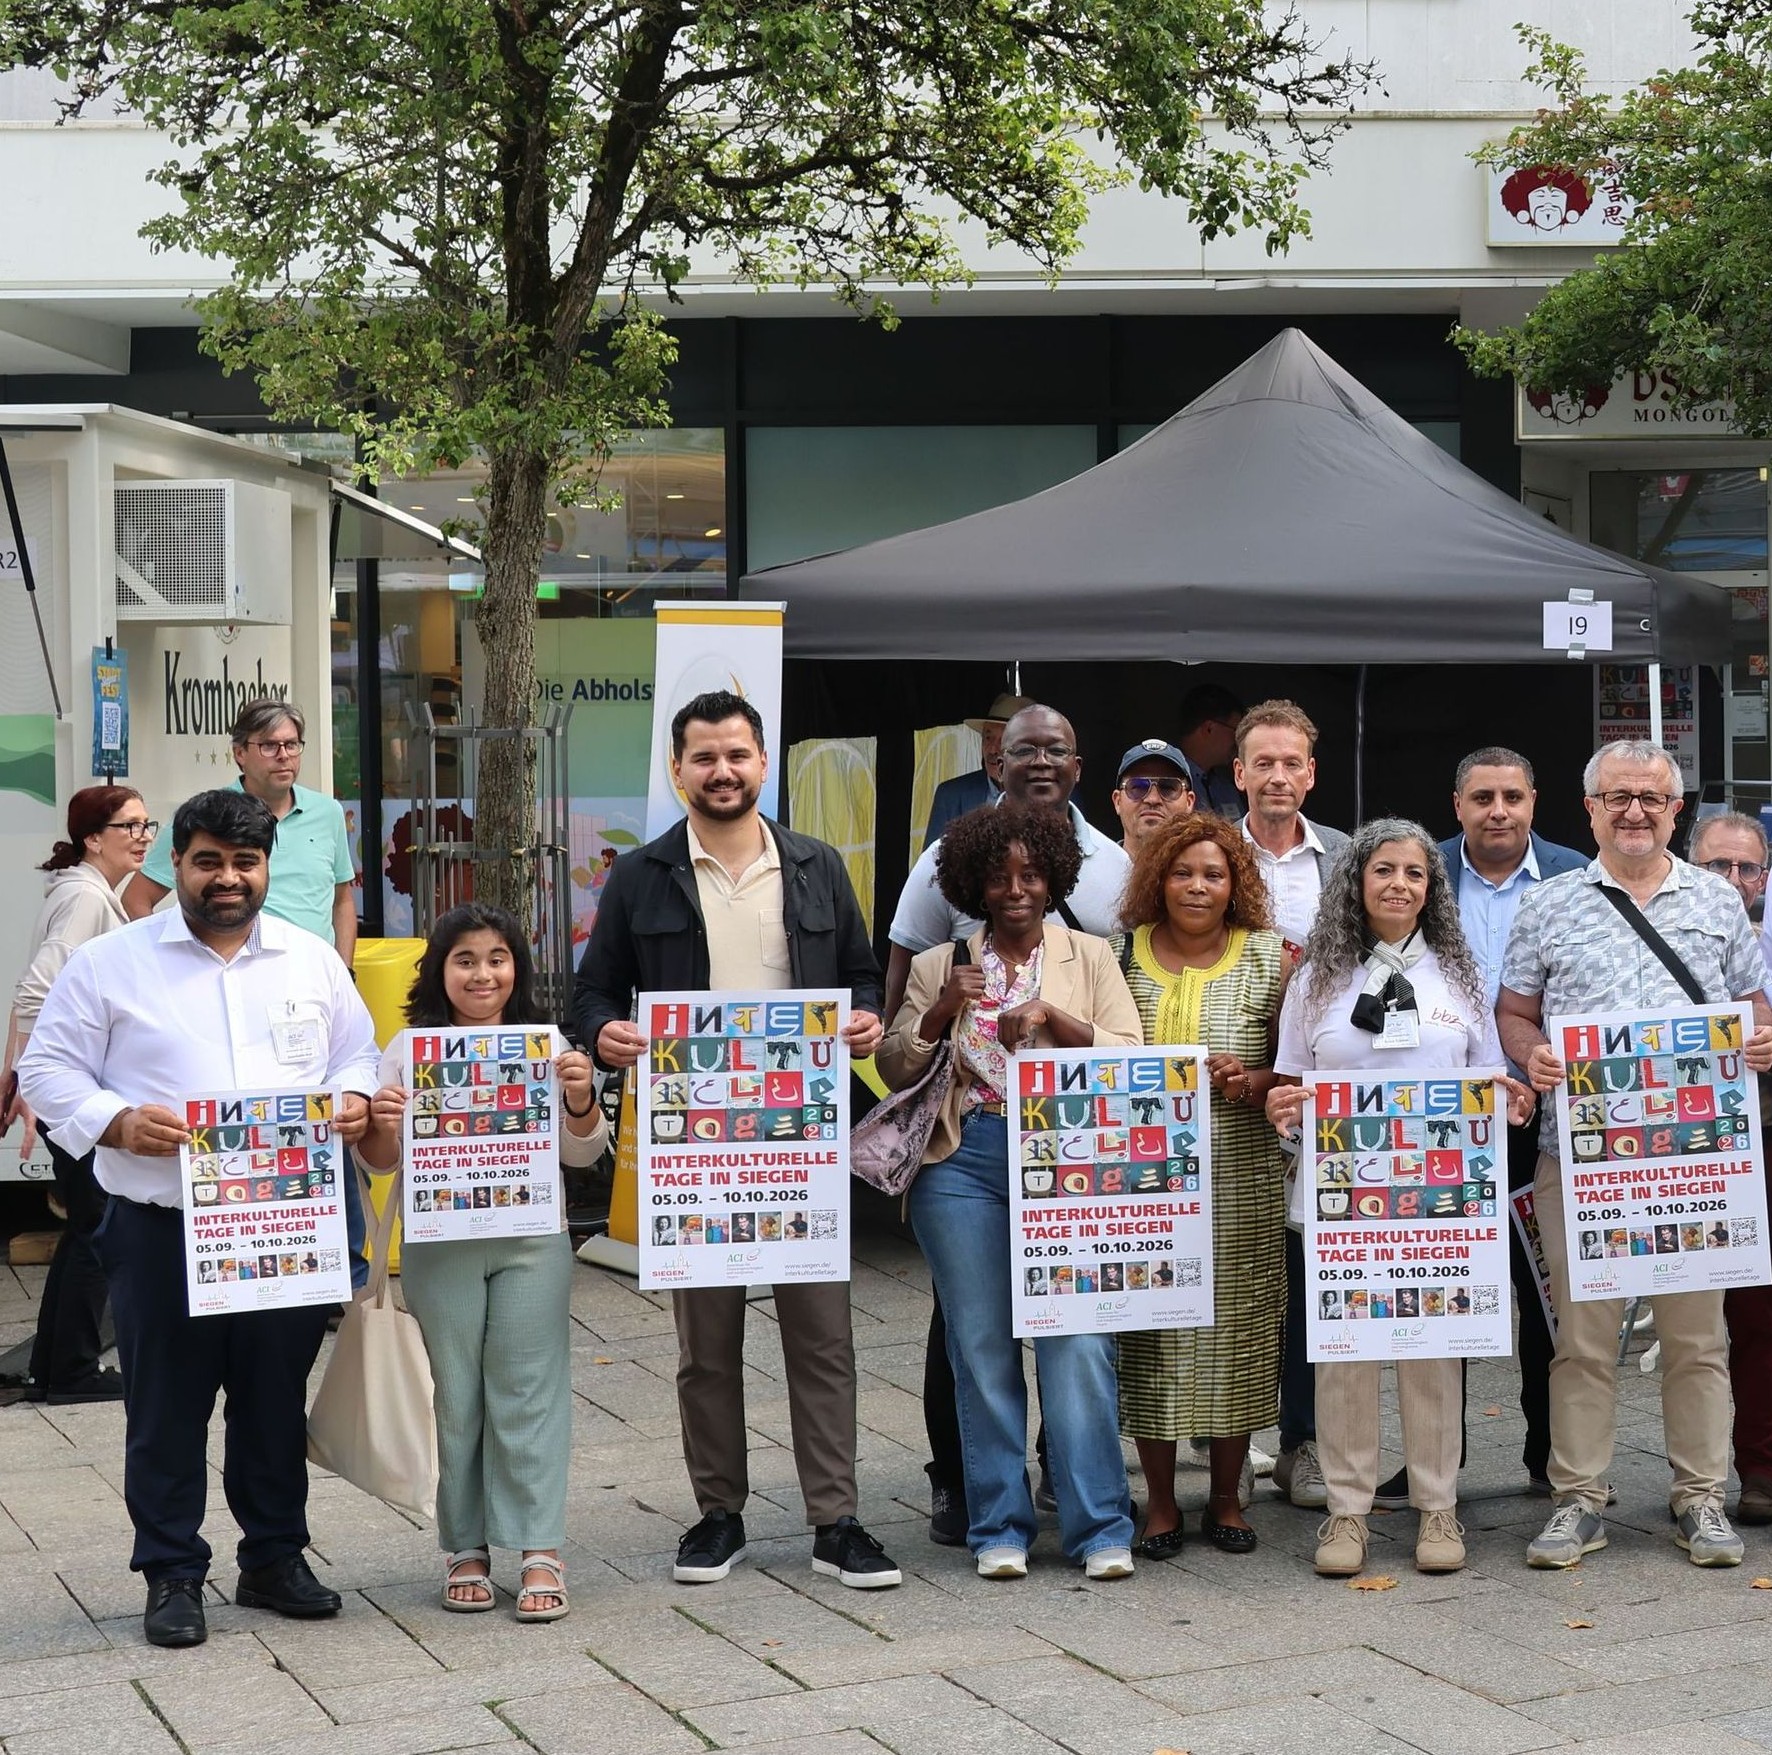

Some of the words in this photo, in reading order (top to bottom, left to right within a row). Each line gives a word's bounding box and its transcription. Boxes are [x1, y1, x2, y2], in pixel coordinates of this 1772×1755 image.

[1633, 408, 1730, 423] MONGOL
[572, 678, 656, 701] Abhols
[412, 1140, 551, 1157] INTERKULTURELLE
[412, 1158, 451, 1170] TAGE
[457, 1157, 472, 1167] IN
[477, 1154, 530, 1166] SIEGEN
[650, 1151, 837, 1169] INTERKULTURELLE
[413, 1173, 451, 1183] 05.09.
[466, 1169, 530, 1180] 10.10.2026
[650, 1172, 703, 1187] TAGE
[710, 1172, 731, 1185] IN
[737, 1169, 808, 1184] SIEGEN
[1573, 1161, 1752, 1187] INTERKULTURELLE
[651, 1193, 703, 1205] 05.09.
[722, 1190, 808, 1203] 10.10.2026
[1574, 1188, 1624, 1204] TAGE
[1631, 1186, 1651, 1200] IN
[1657, 1179, 1726, 1198] SIEGEN
[193, 1205, 337, 1226] INTERKULTURELLE
[1022, 1202, 1200, 1223] INTERKULTURELLE
[1577, 1207, 1626, 1222] 05.09.
[1644, 1199, 1727, 1216] 10.10.2026
[193, 1226, 234, 1240] TAGE
[240, 1225, 256, 1236] IN
[261, 1220, 316, 1234] SIEGEN
[1022, 1225, 1072, 1240] TAGE
[1079, 1224, 1099, 1237] IN
[1105, 1220, 1173, 1236] SIEGEN
[1317, 1228, 1497, 1245] INTERKULTURELLE
[195, 1242, 235, 1254] 05.09.
[250, 1235, 317, 1249] 10.10.2026
[1023, 1245, 1072, 1258] 05.09.
[1091, 1240, 1173, 1254] 10.10.2026
[1317, 1248, 1367, 1262] TAGE
[1374, 1248, 1394, 1261] IN
[1401, 1246, 1469, 1260] SIEGEN
[1318, 1268, 1367, 1281] 05.09.
[1387, 1266, 1470, 1279] 10.10.2026
[1582, 1281, 1613, 1289] SIEGEN
